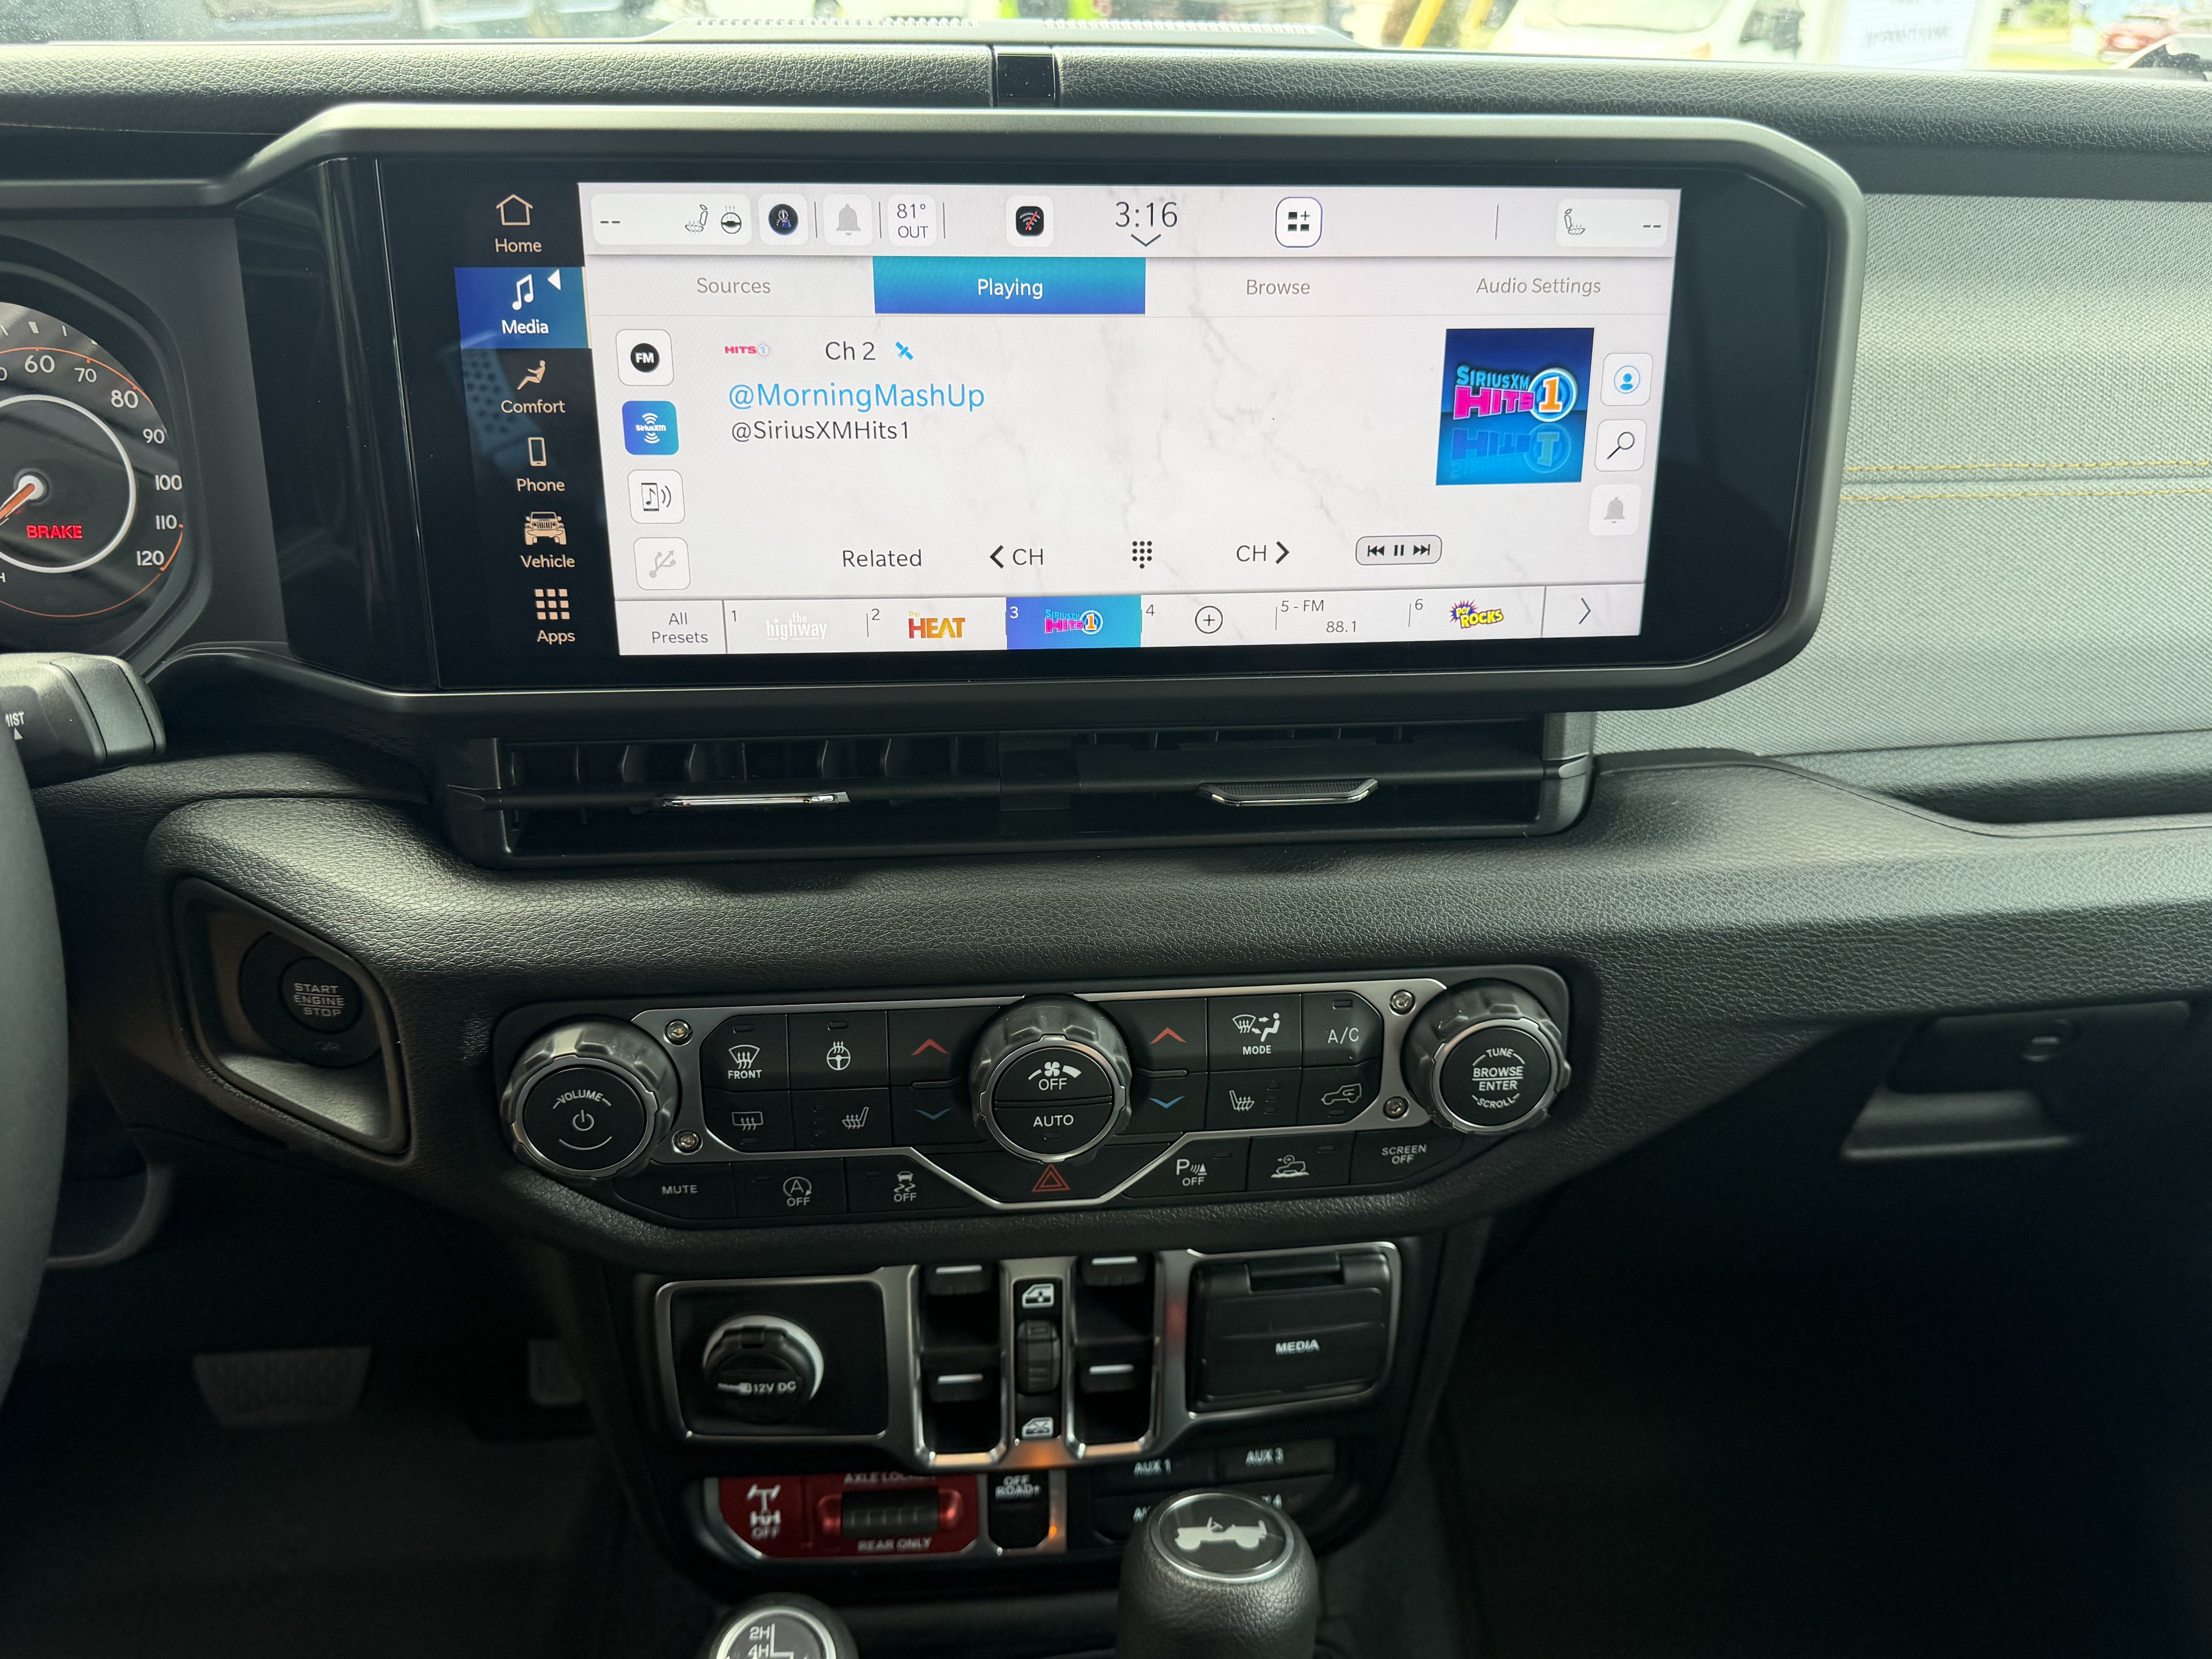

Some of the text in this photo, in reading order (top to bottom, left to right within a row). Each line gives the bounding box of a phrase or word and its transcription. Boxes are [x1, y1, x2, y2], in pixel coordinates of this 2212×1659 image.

[897, 203, 926, 218] 81°
[1115, 201, 1178, 228] 3:16
[898, 226, 928, 238] OUT
[495, 239, 542, 252] Home
[697, 278, 771, 294] Sources
[977, 278, 1043, 299] Playing
[1247, 279, 1310, 295] Browse
[1476, 278, 1601, 297] Audio Settings
[501, 319, 549, 334] Media
[635, 352, 654, 363] FM
[826, 342, 876, 361] Ch 2
[24, 355, 55, 373] 60
[74, 368, 97, 383] 70
[111, 390, 139, 409] 80
[729, 382, 985, 412] @MorningMashUp
[1453, 376, 1562, 420] HITS 1
[501, 399, 566, 414] Comfort
[143, 429, 165, 444] 90
[732, 421, 908, 443] @SiriusXMHits1
[155, 474, 182, 491] 100
[516, 478, 565, 491] Phone
[156, 514, 177, 530] 110
[26, 524, 83, 540] BRAKE
[136, 550, 165, 566] 120
[842, 549, 922, 567] Related
[1012, 548, 1043, 566] CH
[1236, 545, 1266, 562] CH
[520, 555, 575, 568] Vehicle
[1146, 604, 1155, 616] 4
[1281, 601, 1289, 612] 5
[1304, 600, 1324, 612] FM
[1415, 599, 1423, 610] 6
[669, 612, 687, 625] All
[732, 610, 736, 622] 1
[792, 611, 807, 623] the
[872, 609, 880, 621] 2
[1010, 606, 1019, 619] 3
[1460, 609, 1504, 629] ROCKS
[766, 619, 828, 640] highway
[908, 618, 965, 639] HEAT
[1045, 613, 1097, 634] HITS 1
[1326, 621, 1356, 632] 88.1
[537, 630, 575, 644] Apps
[652, 631, 708, 644] Presets
[294, 983, 338, 994] START
[295, 994, 345, 1006] ENGINE
[304, 1007, 341, 1017] STOP
[1328, 1027, 1359, 1044] A/C
[1243, 1045, 1271, 1054] MODE
[1486, 1047, 1514, 1058] TUNE
[728, 1069, 762, 1079] FRONT
[1473, 1066, 1524, 1078] BROWSE
[1039, 1078, 1067, 1091] OFF
[1479, 1080, 1518, 1091] ENTER
[557, 1089, 603, 1104] VOLUME
[1477, 1096, 1516, 1109] SCROLL
[1033, 1115, 1074, 1127] AUTO
[1381, 1144, 1427, 1156] SCREEN
[1176, 1159, 1190, 1175] P
[1391, 1154, 1414, 1165] OFF
[1182, 1177, 1205, 1186] OFF
[661, 1185, 698, 1194] MUTE
[893, 1192, 917, 1202] OFF
[787, 1197, 811, 1206] OFF
[1276, 1339, 1320, 1355] MEDIA
[753, 1381, 796, 1394] 12V DC
[1246, 1449, 1274, 1466] AUX
[1134, 1460, 1161, 1476] AUX
[1003, 1474, 1030, 1486] OFF
[751, 1525, 780, 1541] OFF
[857, 1537, 932, 1553] REAR ONLY
[749, 1625, 770, 1640] 2H
[747, 1644, 769, 1659] 4H
